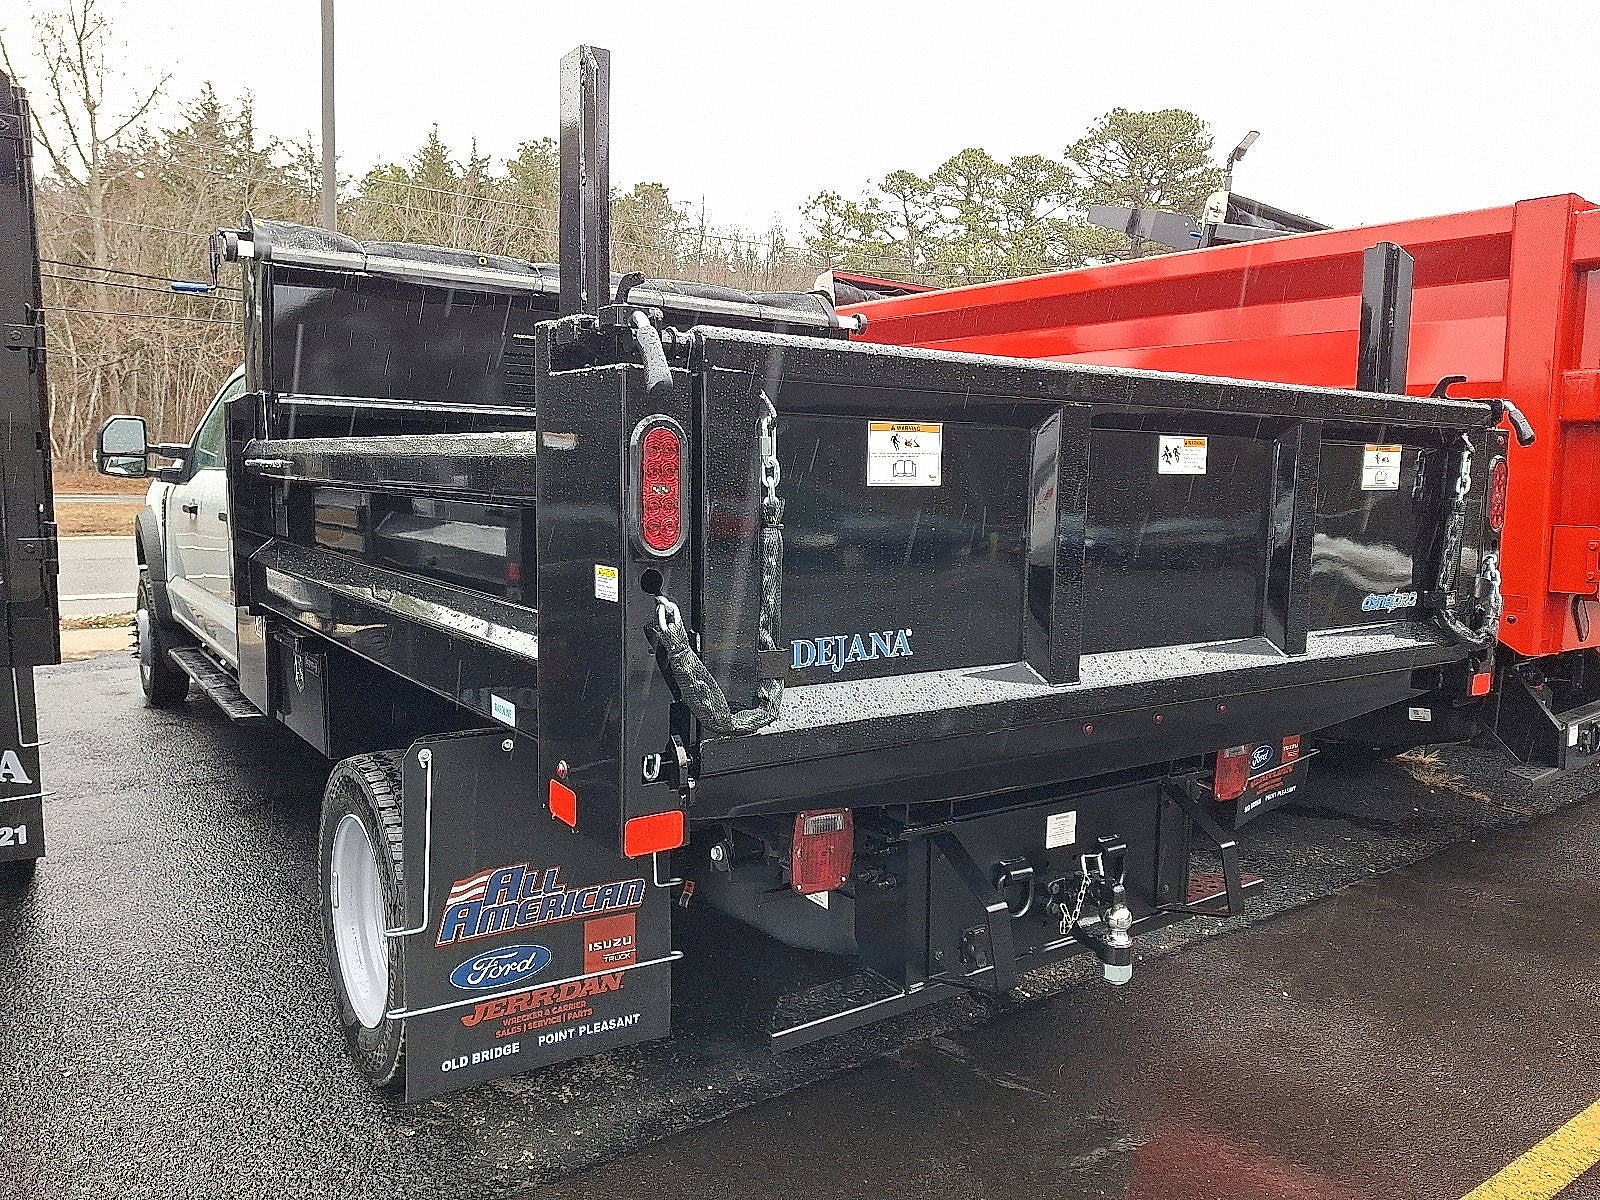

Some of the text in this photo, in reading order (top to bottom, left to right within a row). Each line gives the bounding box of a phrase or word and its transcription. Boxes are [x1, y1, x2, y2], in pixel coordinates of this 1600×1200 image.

[790, 630, 913, 672] DEJANA
[588, 936, 632, 952] ISUZU
[603, 951, 631, 963] TRUCK
[467, 951, 537, 985] Ford
[495, 1008, 593, 1039] SALES SERVICE PARTS
[502, 1010, 543, 1027] WRECKER
[551, 1000, 587, 1014] CARRIER
[538, 1013, 641, 1046] POINT PLEASANT
[440, 1042, 521, 1073] OLD BRIDGE
